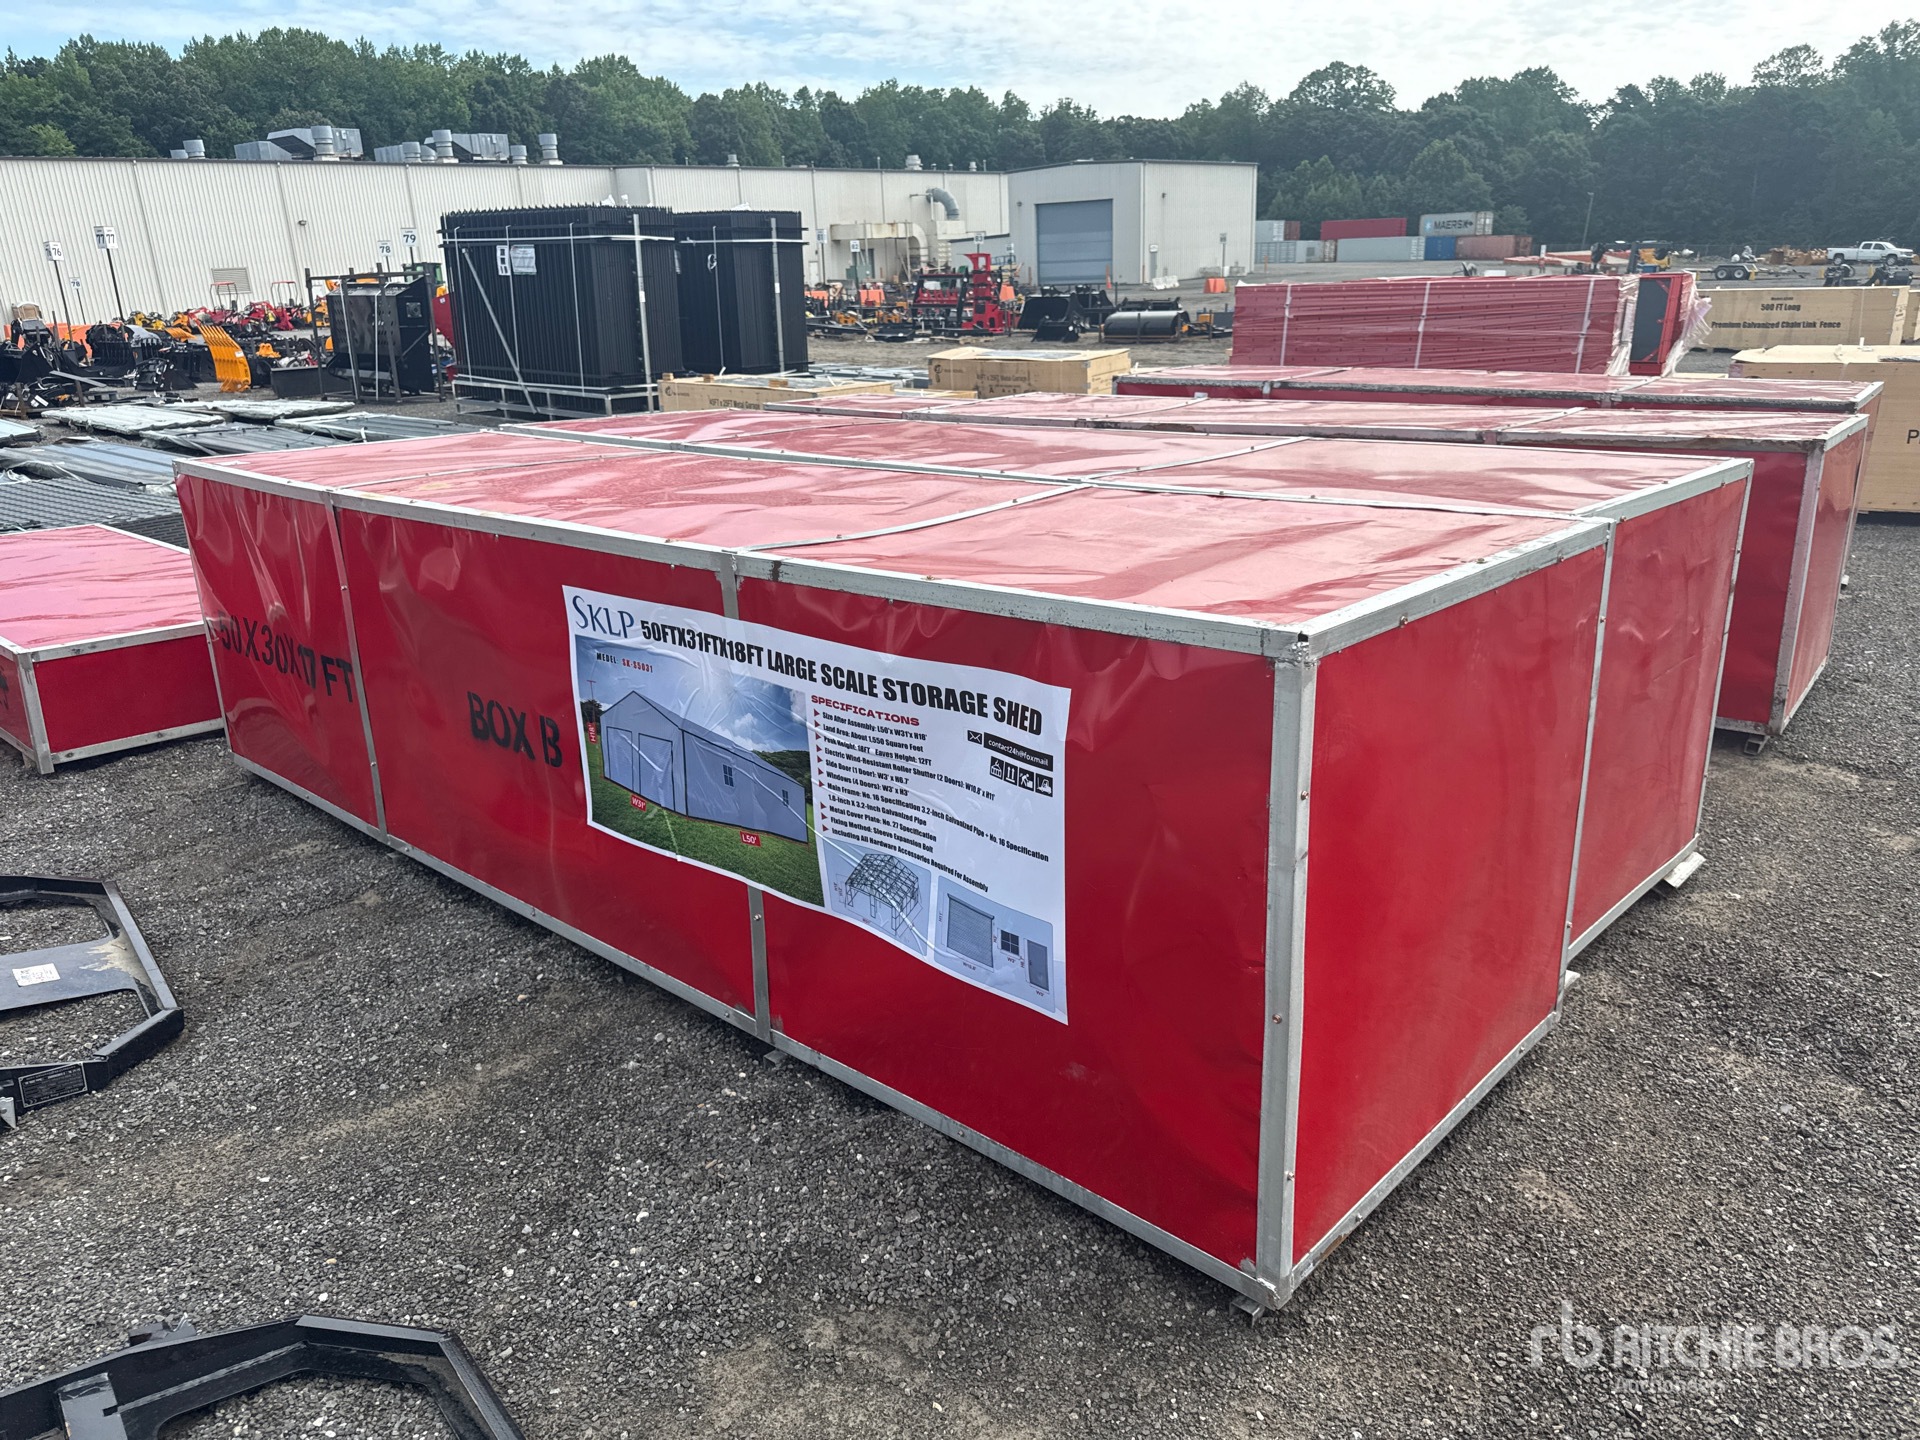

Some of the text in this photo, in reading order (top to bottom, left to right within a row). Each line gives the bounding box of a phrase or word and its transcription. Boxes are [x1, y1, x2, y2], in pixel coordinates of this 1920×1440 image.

[1434, 220, 1470, 230] MAERSK
[96, 234, 104, 244] 77
[106, 234, 114, 244] 77
[379, 245, 391, 253] 78
[403, 234, 416, 243] 79
[52, 247, 62, 256] 76
[1907, 430, 1920, 444] P
[572, 595, 635, 638] SKLP
[321, 654, 353, 703] FT
[640, 620, 1042, 736] 50FTX31FTX18FT LARGE SCALE STORAGE SHED
[811, 695, 920, 726] SPECIFICATIONS
[466, 691, 563, 768] BOX B
[822, 712, 833, 721] Size
[834, 715, 847, 724] After
[848, 718, 876, 732] Assembly:
[823, 724, 835, 733] Land
[836, 728, 850, 737] Area:
[851, 732, 868, 741] About
[885, 739, 908, 750] Square
[909, 743, 924, 752] Feet
[825, 748, 845, 759] Electric
[846, 753, 892, 770] Wind-Resistant
[893, 764, 912, 773] Roller
[913, 766, 936, 779] Shutter
[858, 744, 870, 754] 18FT
[875, 749, 893, 759] Eaves
[894, 752, 918, 764] Height:
[918, 757, 932, 766] 12FT
[826, 759, 838, 768] Side
[838, 763, 851, 773] Door
[858, 766, 876, 777] Door):
[826, 770, 852, 783] Windows
[852, 777, 859, 786] (4
[860, 780, 881, 790] Doors):
[827, 782, 841, 791] Main
[842, 787, 861, 797] Frame:
[880, 795, 920, 812] Specification
[945, 814, 973, 832] Galvanized
[974, 825, 985, 837] Pipe
[989, 833, 998, 843] No.
[999, 838, 1005, 846] 16
[1006, 840, 1049, 862] Specification
[829, 805, 846, 815] Metal
[846, 810, 864, 820] Cover
[864, 814, 882, 824] Plate:
[900, 823, 937, 842] Specification
[881, 807, 913, 822] Galvanized
[914, 817, 927, 826] Pipe
[830, 816, 934, 853] Fixing Method: Sleeve Expansion Bolt
[832, 828, 860, 841] Including
[869, 836, 897, 850] Hardware
[898, 846, 931, 863] Accessories
[931, 858, 954, 875] Required
[954, 870, 963, 879] For
[963, 874, 988, 892] Assembly
